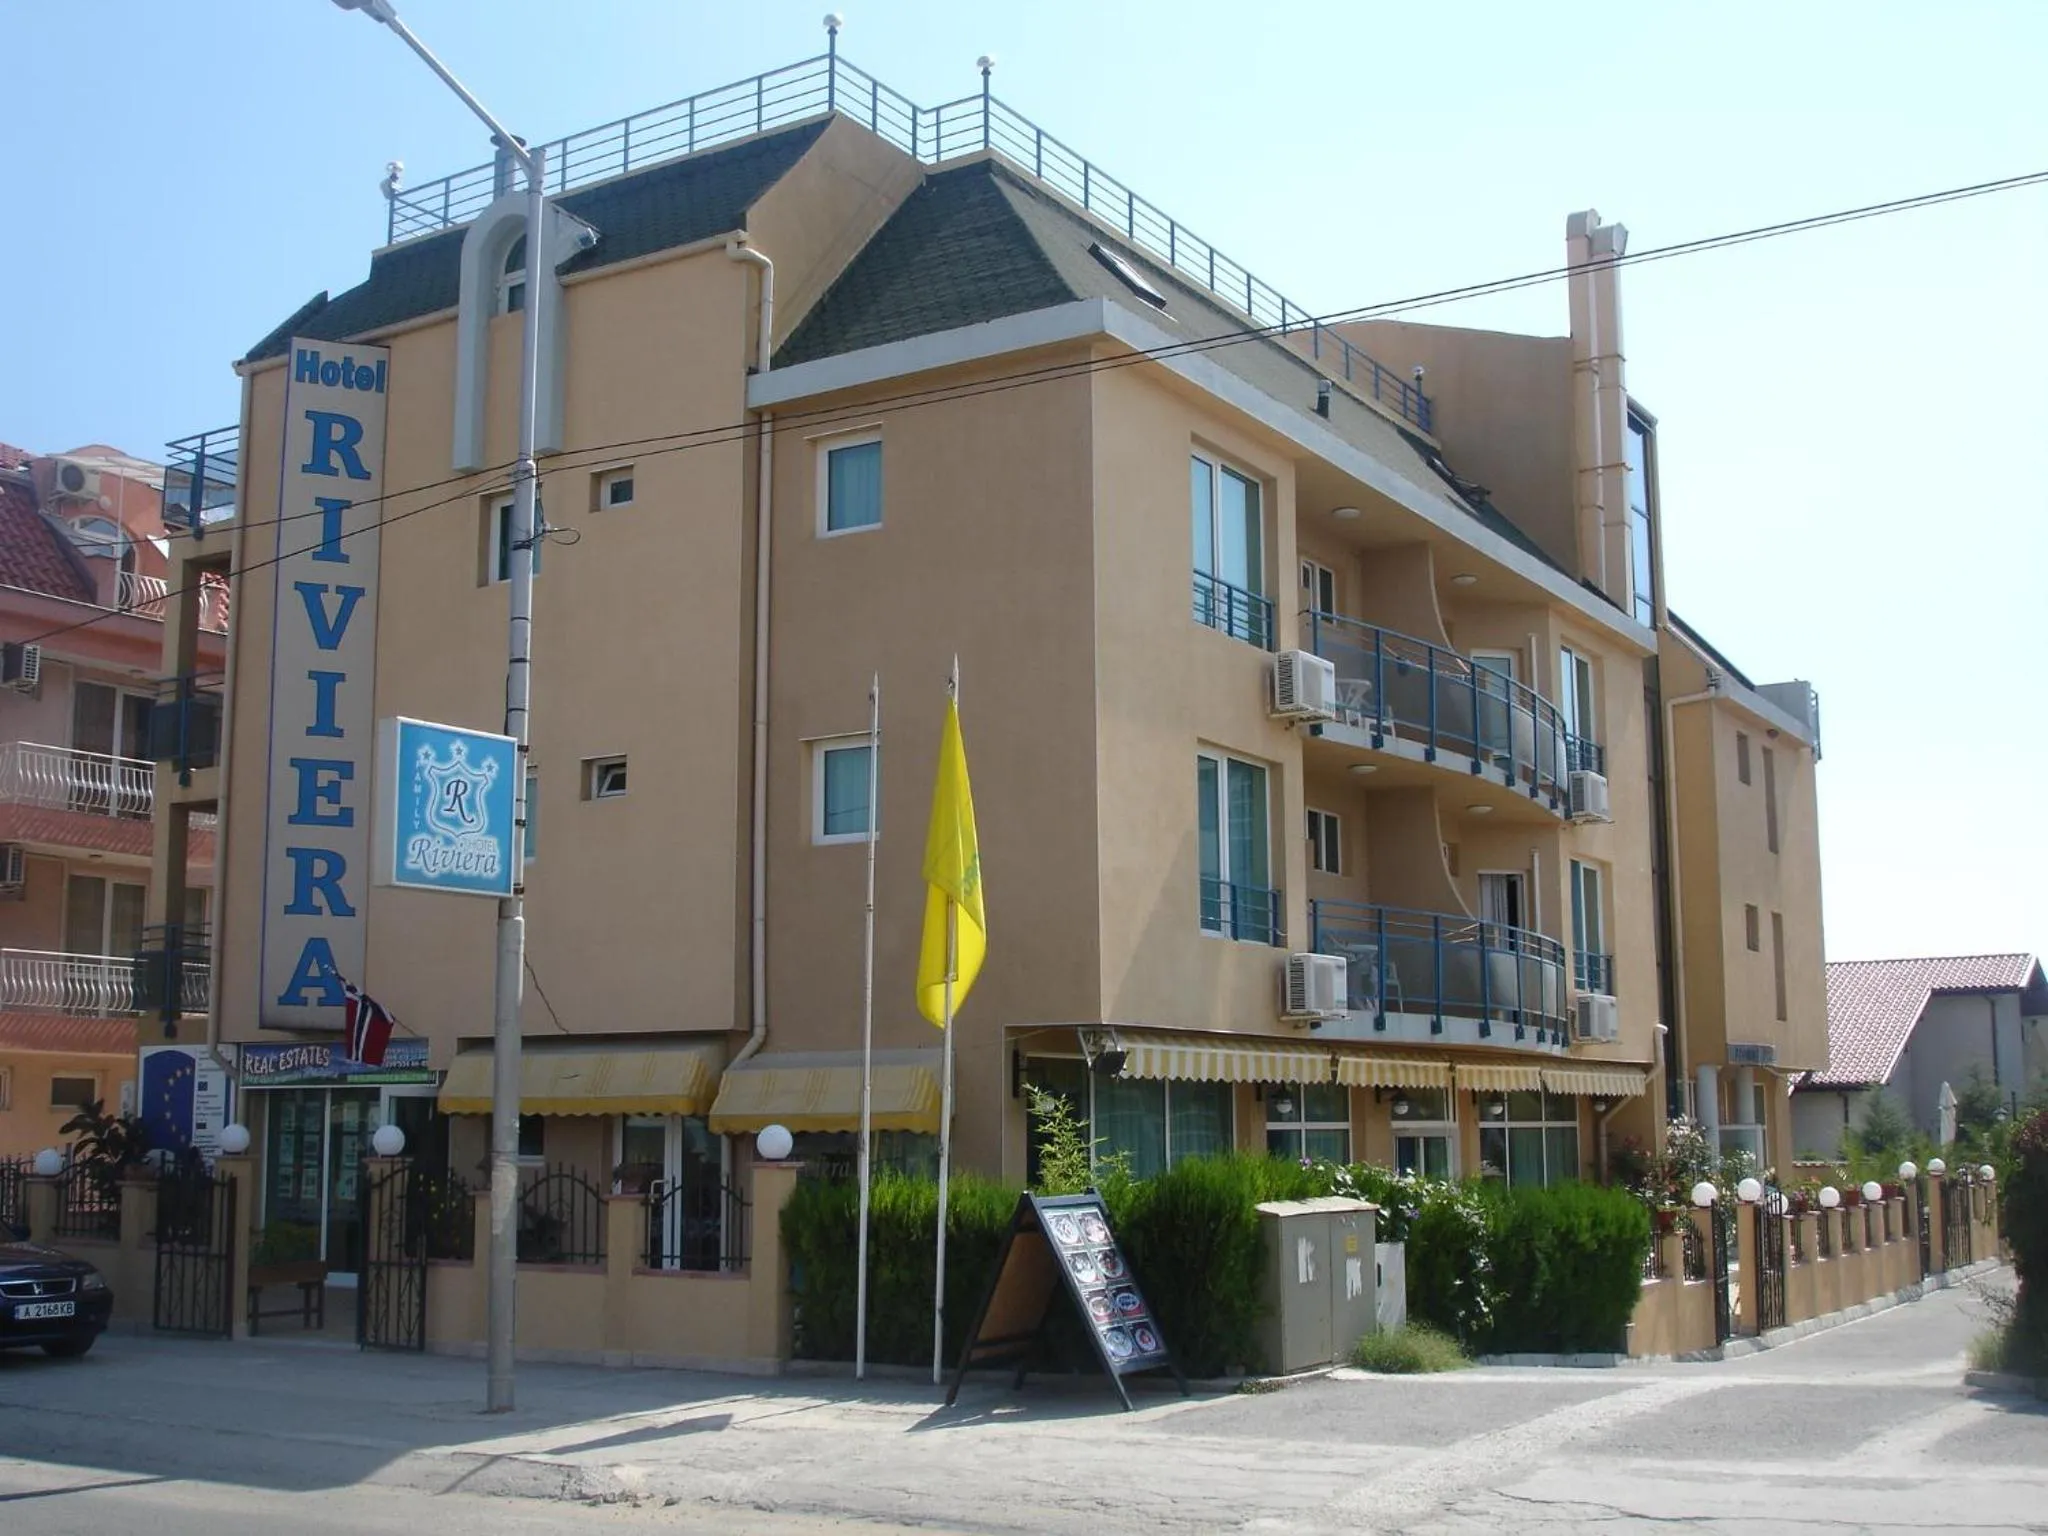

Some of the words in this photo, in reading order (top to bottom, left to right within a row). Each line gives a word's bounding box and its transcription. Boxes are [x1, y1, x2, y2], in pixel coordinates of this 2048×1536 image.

[294, 348, 387, 394] Hotel
[277, 409, 372, 1008] RIVIERA
[443, 778, 475, 824] R
[410, 838, 497, 874] Riviera
[244, 1053, 275, 1075] REAL
[279, 1045, 330, 1071] ESTATES
